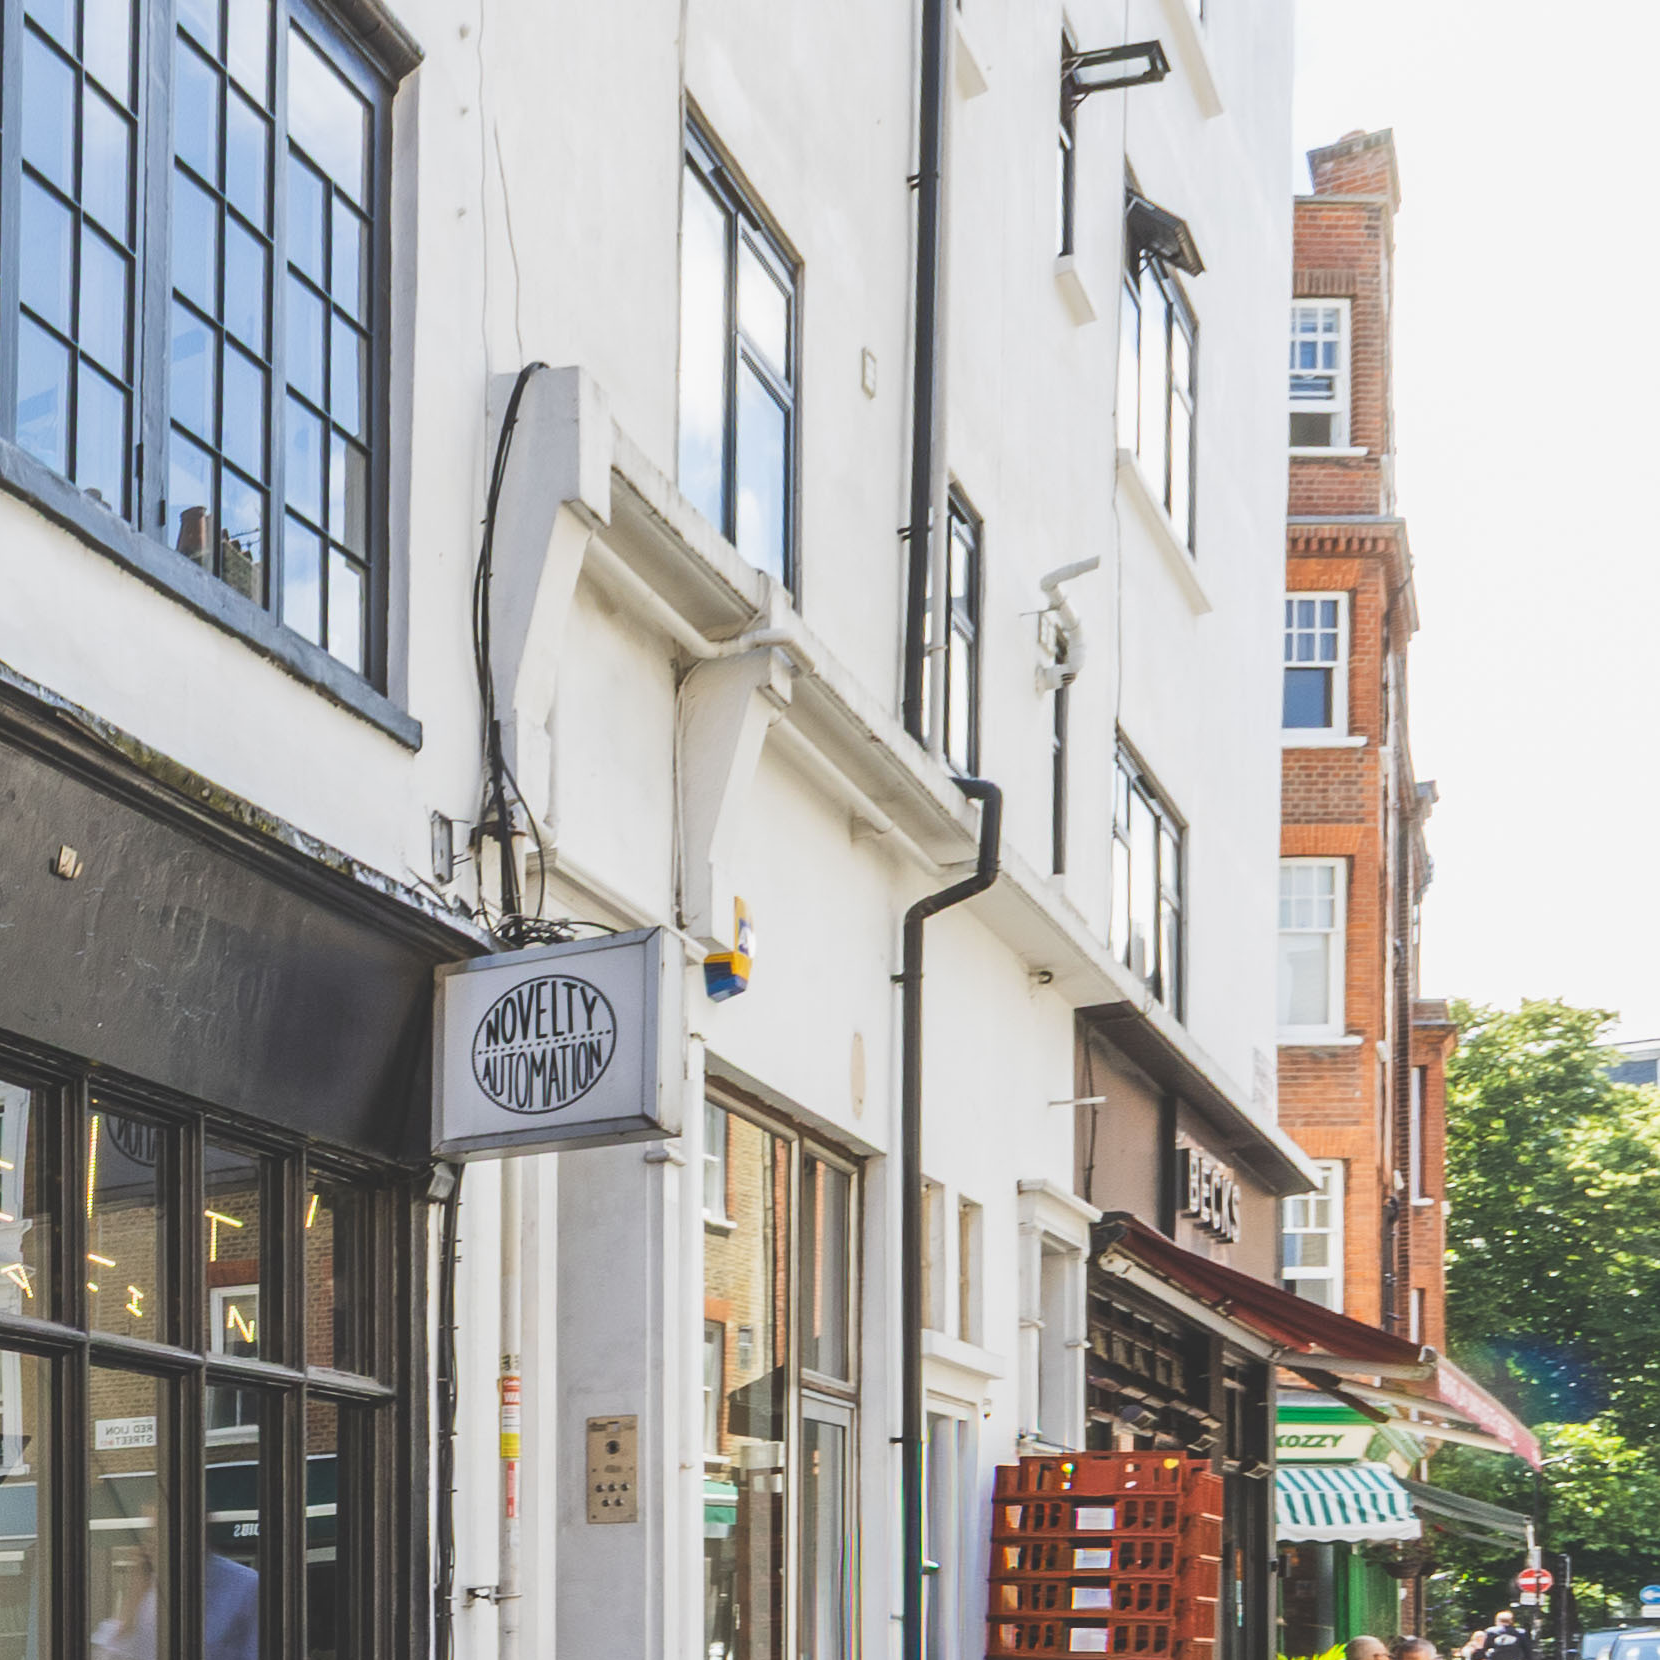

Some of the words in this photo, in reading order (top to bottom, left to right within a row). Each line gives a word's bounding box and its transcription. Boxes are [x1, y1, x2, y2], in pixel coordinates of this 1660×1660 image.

[485, 980, 598, 1048] NOVELTY
[482, 1038, 603, 1109] AUTOMATION
[1188, 1147, 1240, 1243] BECKS
